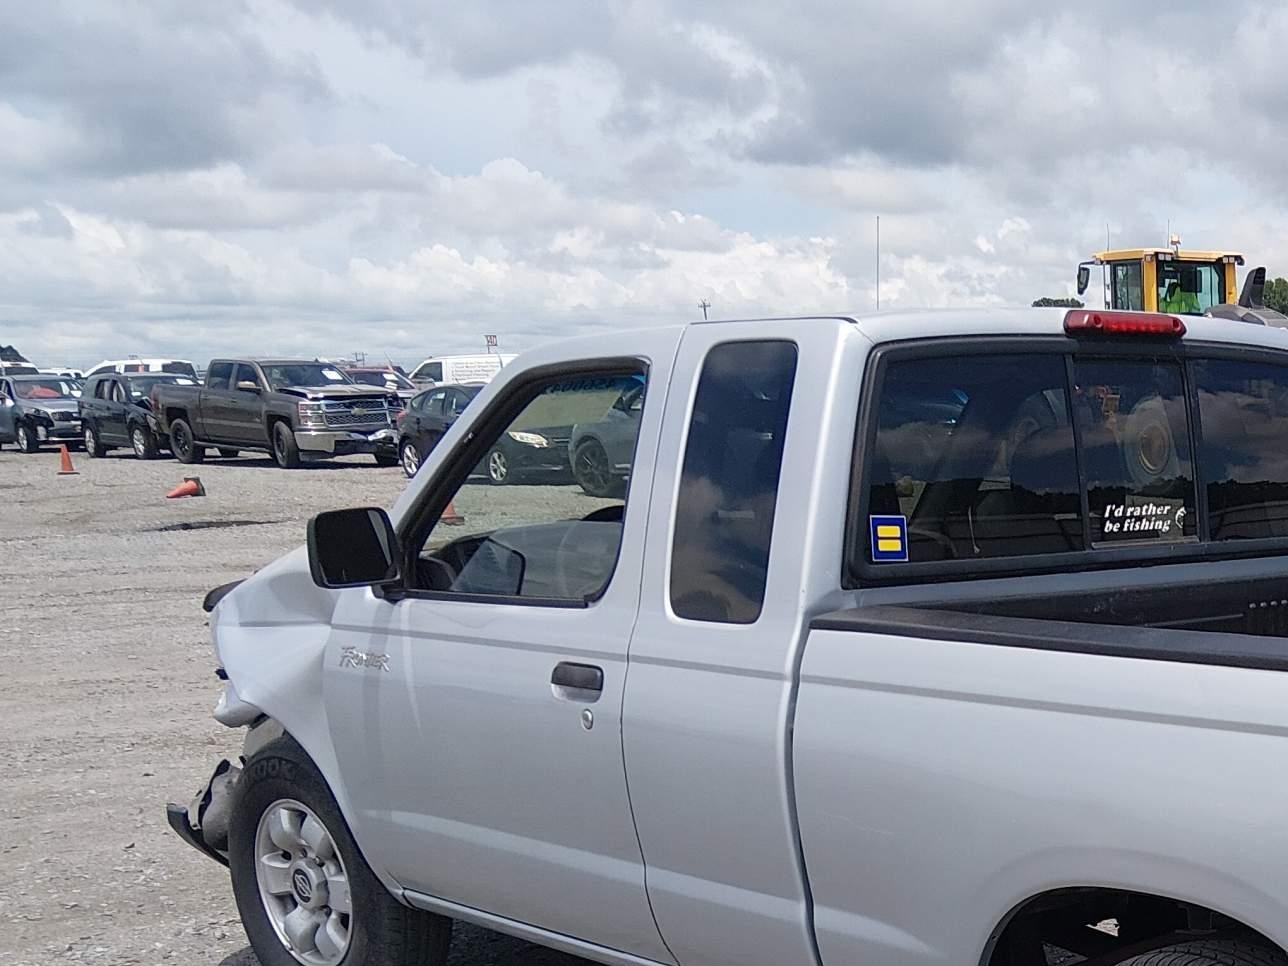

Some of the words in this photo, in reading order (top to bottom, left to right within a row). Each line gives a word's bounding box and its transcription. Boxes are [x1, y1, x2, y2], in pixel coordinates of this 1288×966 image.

[1104, 504, 1124, 518] I'd
[1126, 503, 1171, 516] rather
[1104, 520, 1121, 533] be
[1123, 517, 1171, 533] fishing
